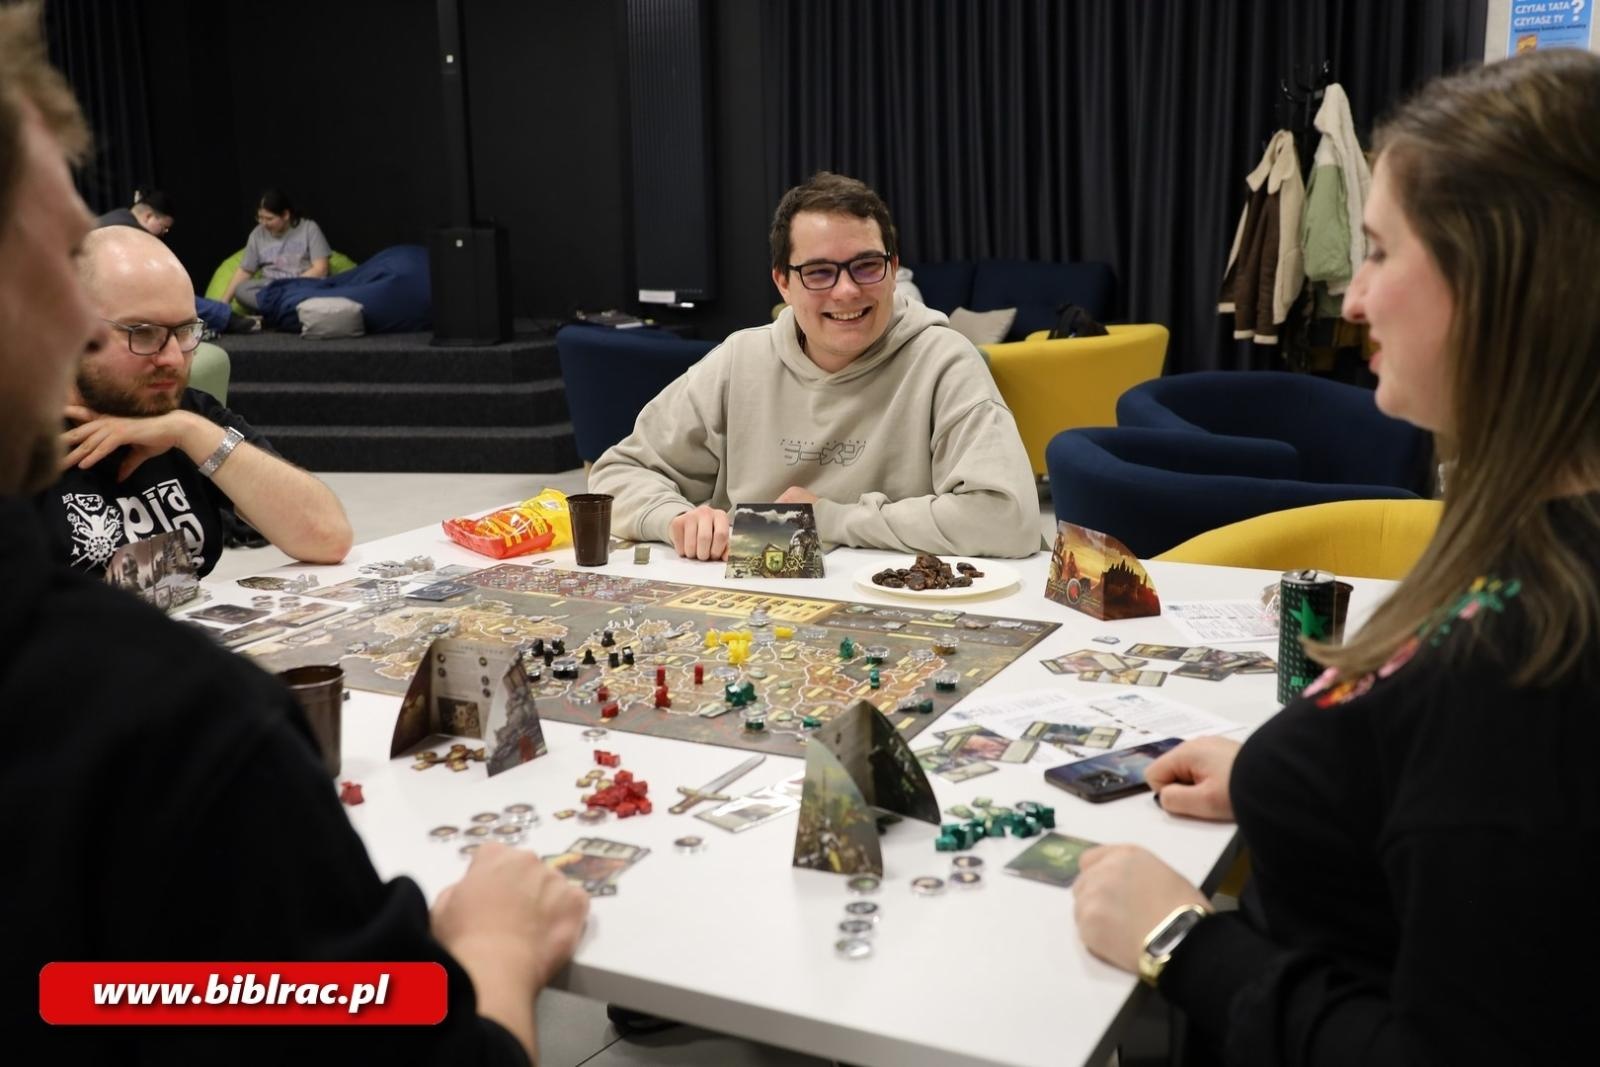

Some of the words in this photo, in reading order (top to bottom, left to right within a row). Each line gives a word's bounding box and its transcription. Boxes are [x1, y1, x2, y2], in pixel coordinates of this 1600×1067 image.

[1549, 2, 1570, 11] TATA
[1514, 15, 1552, 26] CZYTASZ
[1553, 15, 1565, 23] TY
